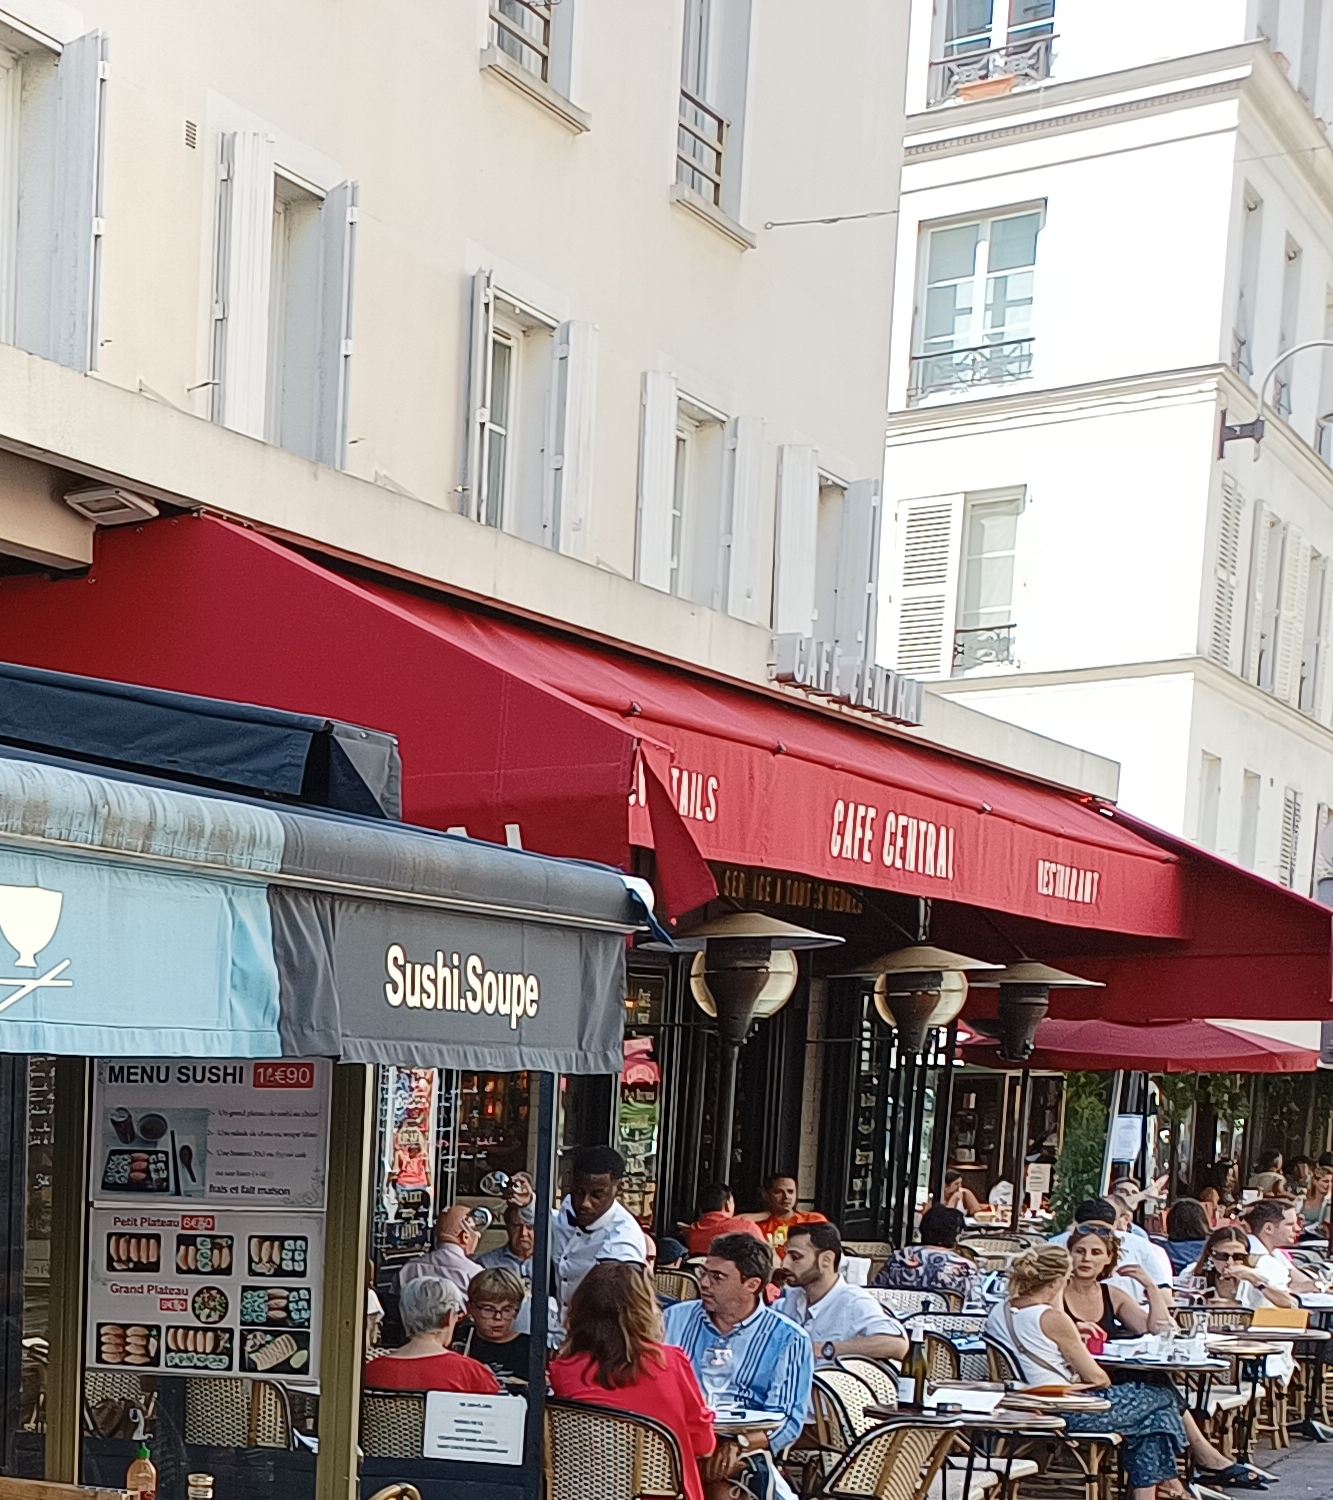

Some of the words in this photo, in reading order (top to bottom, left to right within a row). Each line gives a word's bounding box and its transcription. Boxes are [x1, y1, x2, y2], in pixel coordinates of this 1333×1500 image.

[794, 636, 844, 697] CAFE
[830, 799, 877, 864] CAFE
[883, 811, 955, 882] CENTRAL
[385, 943, 541, 1031] Sushi.Soupe
[108, 1065, 171, 1084] MENU
[175, 1065, 244, 1084] SUSHI
[113, 1216, 138, 1227] Petit
[139, 1216, 180, 1228] Plateau
[110, 1283, 144, 1295] Grand
[146, 1284, 189, 1296] Plateau
